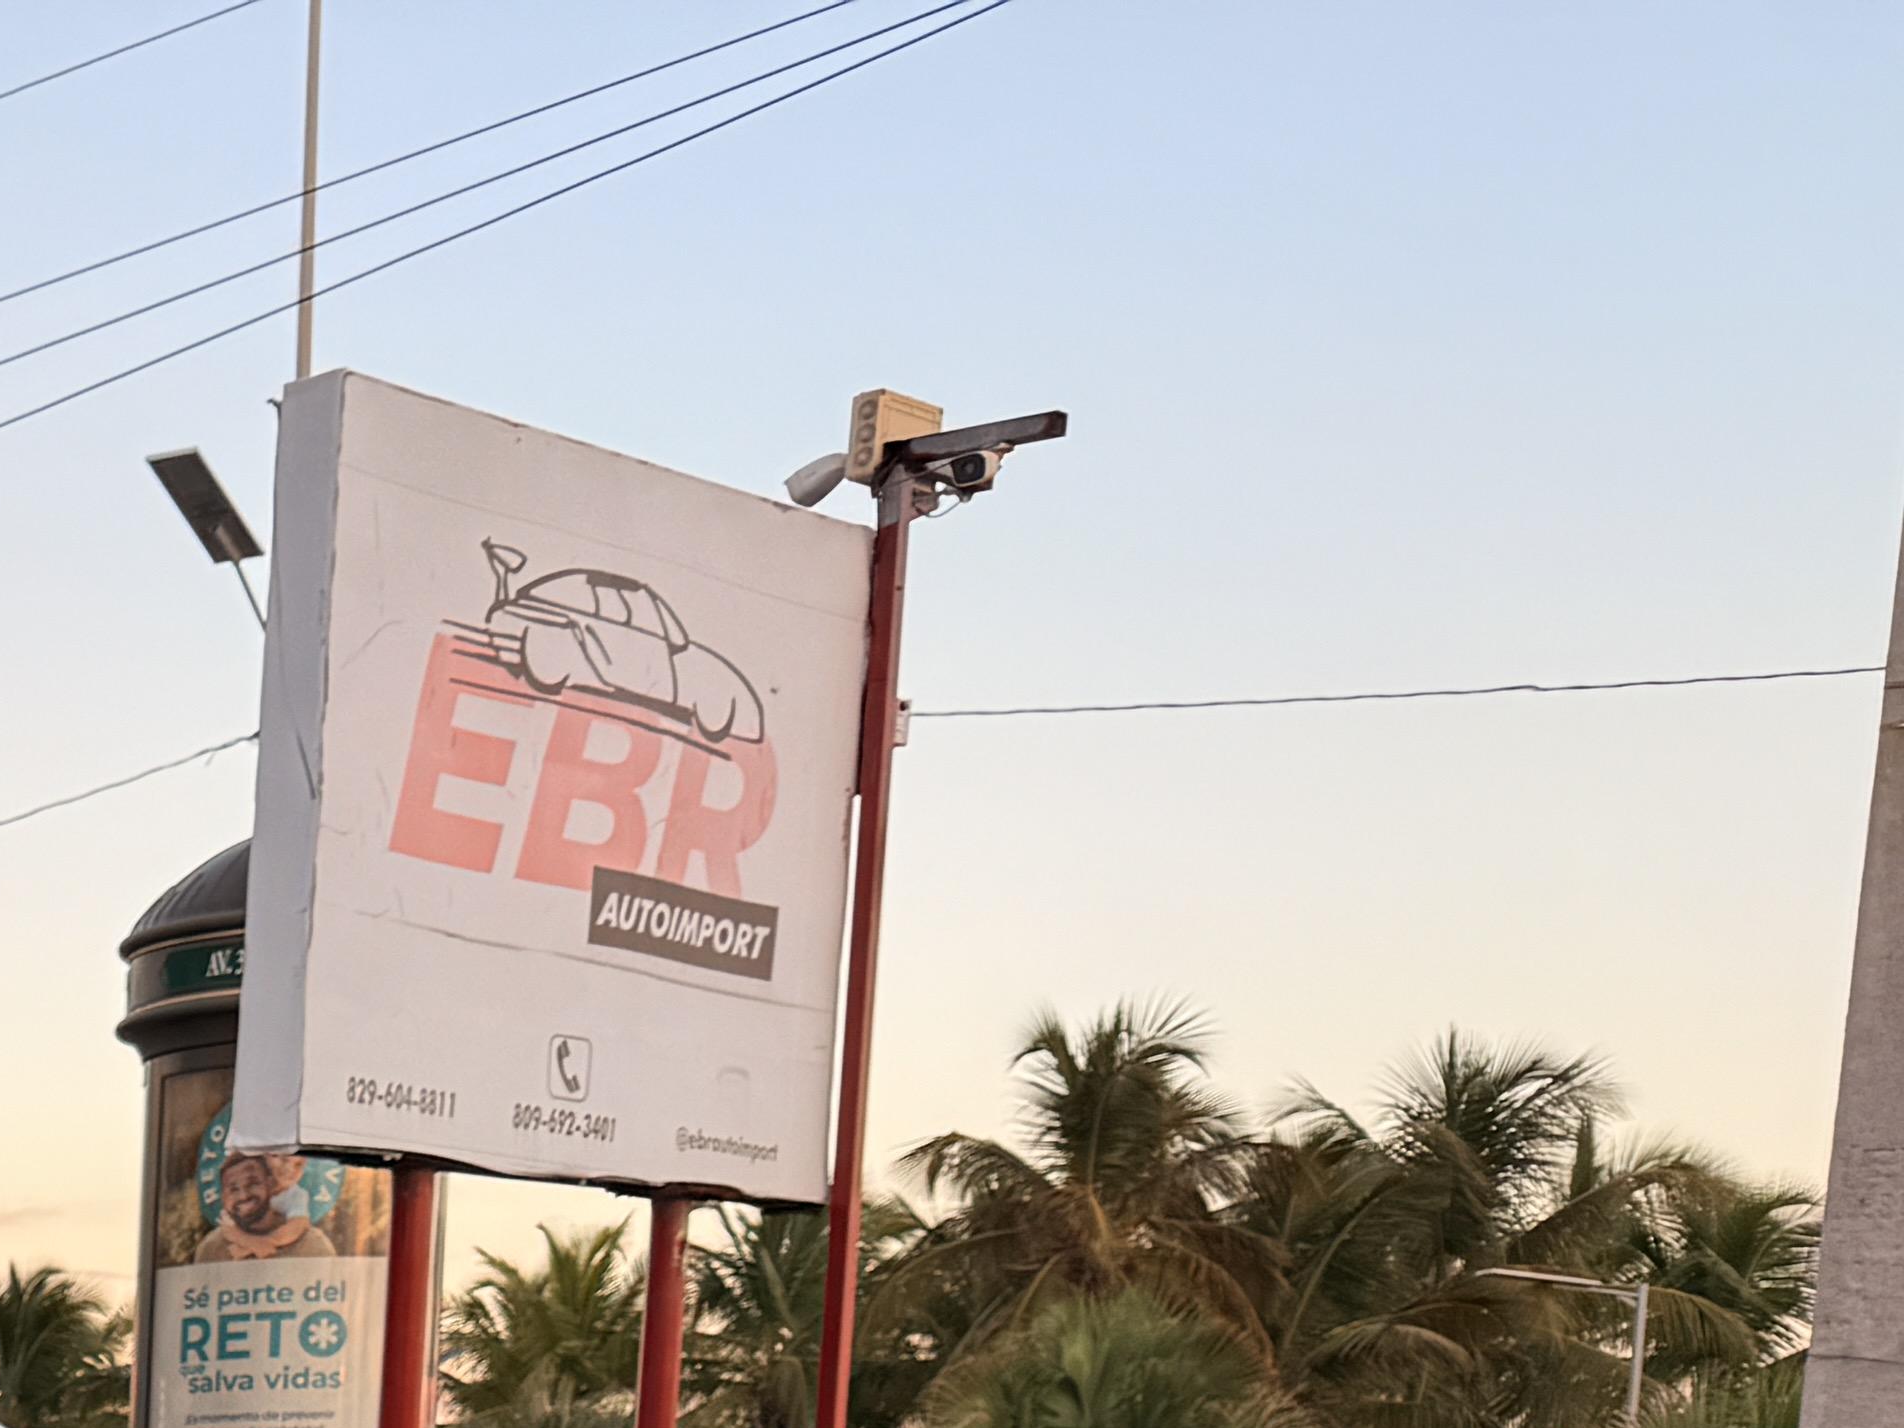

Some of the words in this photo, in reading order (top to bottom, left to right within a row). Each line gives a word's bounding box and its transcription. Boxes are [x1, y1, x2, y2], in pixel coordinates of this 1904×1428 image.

[388, 633, 778, 898] EBR
[596, 892, 770, 959] AUTOIMPORT
[183, 1285, 209, 1310] Sé
[217, 1284, 293, 1311] parte
[302, 1280, 346, 1303] del
[179, 1310, 347, 1363] RETO
[188, 1370, 254, 1394] salva
[264, 1366, 342, 1390] vidas
